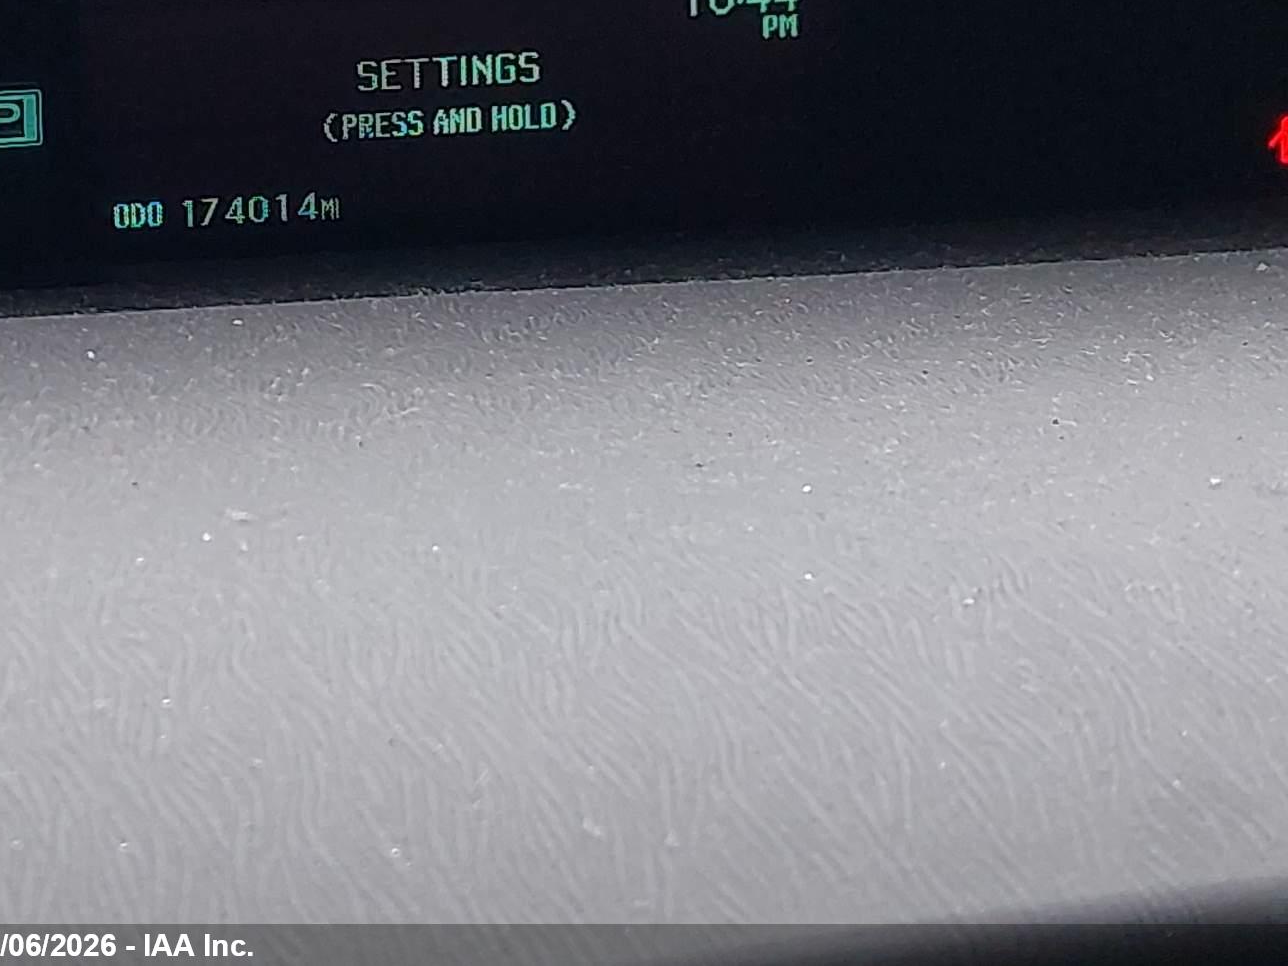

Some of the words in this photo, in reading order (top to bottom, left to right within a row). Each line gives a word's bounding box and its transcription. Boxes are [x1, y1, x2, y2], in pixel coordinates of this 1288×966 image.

[762, 14, 799, 39] PM
[356, 52, 541, 91] SETTINGS
[323, 110, 424, 142] (PRESS
[432, 106, 483, 135] AND
[491, 99, 576, 133] HOLD)
[113, 202, 164, 229] ODO
